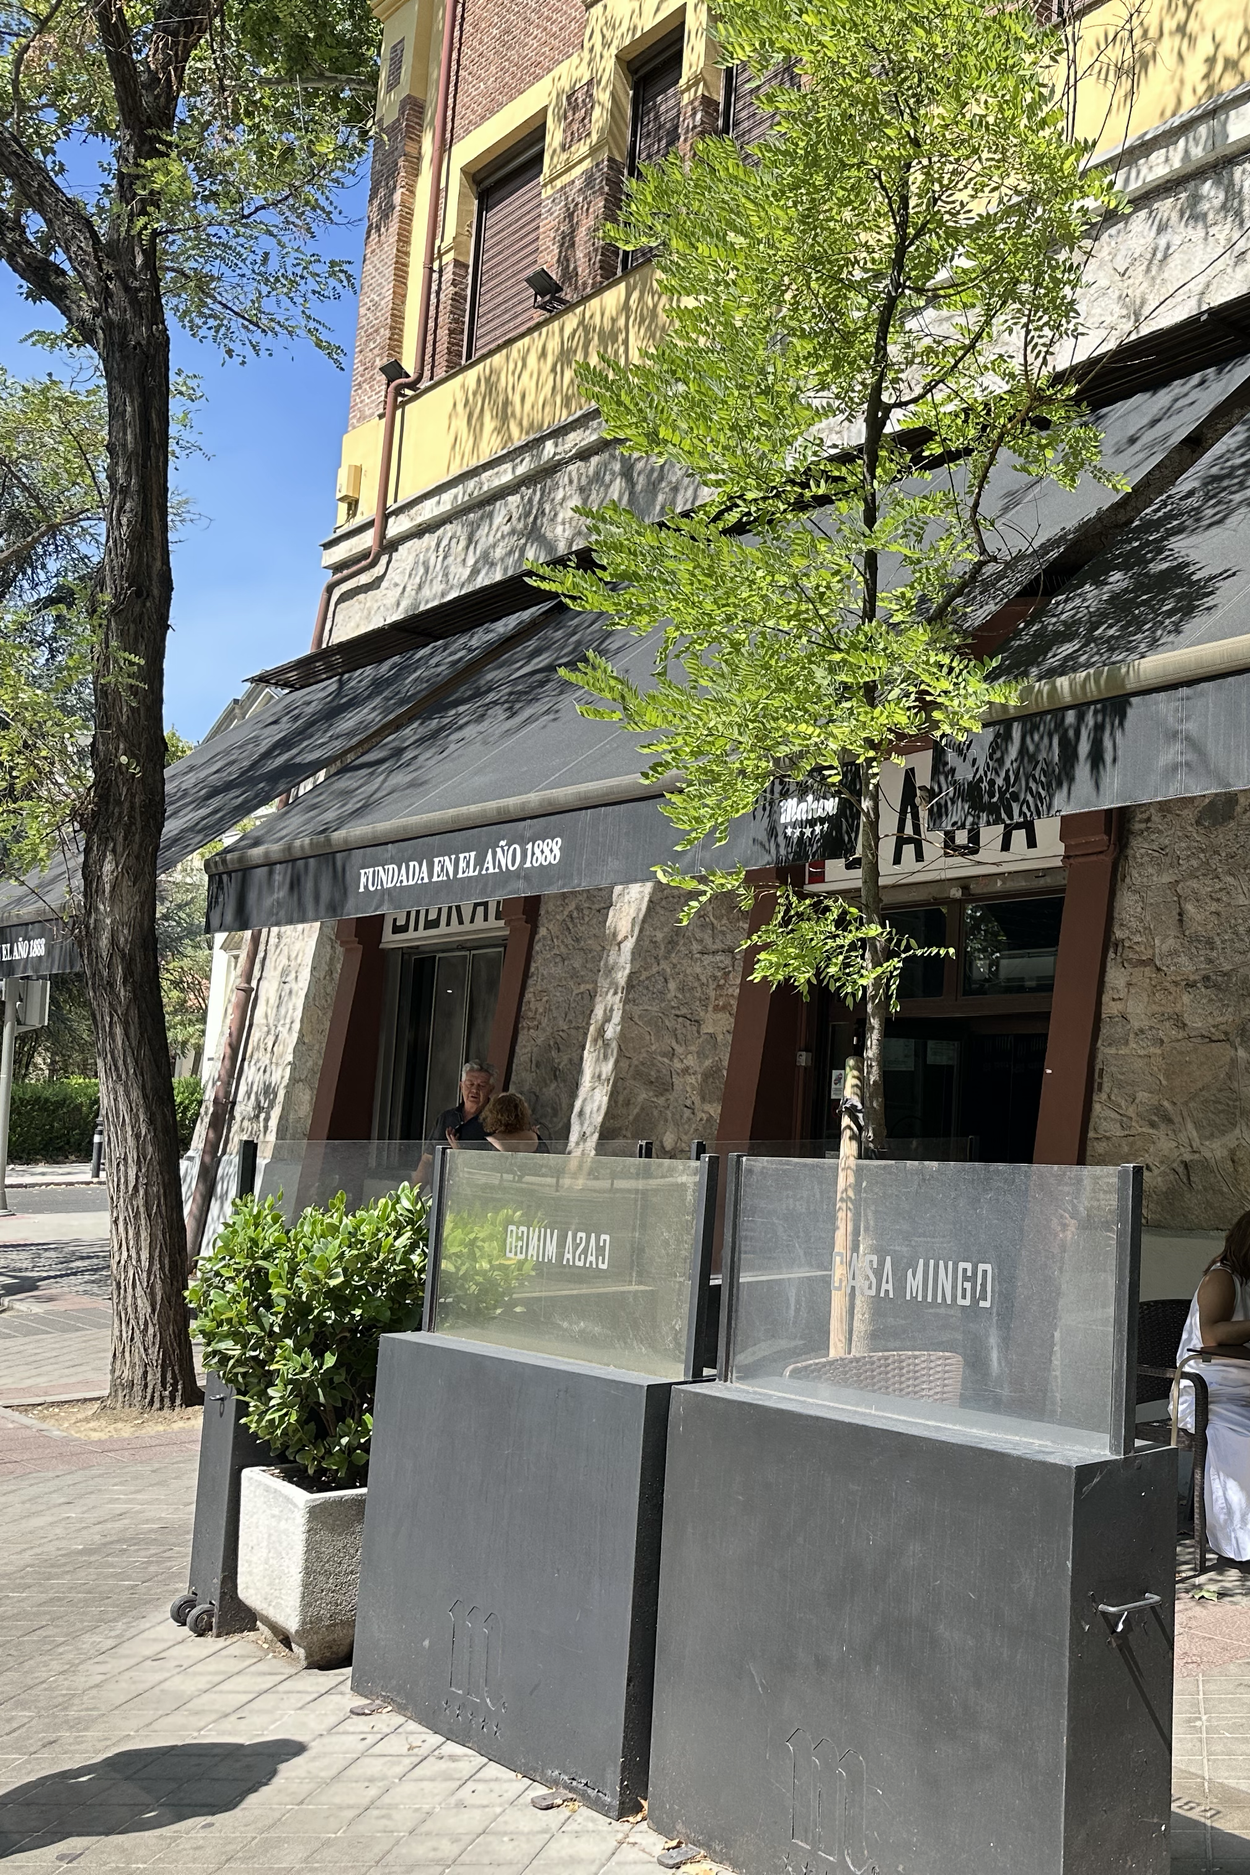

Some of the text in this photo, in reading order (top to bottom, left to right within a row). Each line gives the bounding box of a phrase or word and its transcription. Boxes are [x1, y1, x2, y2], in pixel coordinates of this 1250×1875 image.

[358, 837, 563, 893] FUNDADA EN EL AÑO 1888
[1, 943, 12, 961] EL
[12, 936, 29, 961] AÑO
[830, 1251, 993, 1308] CASA MINGO
